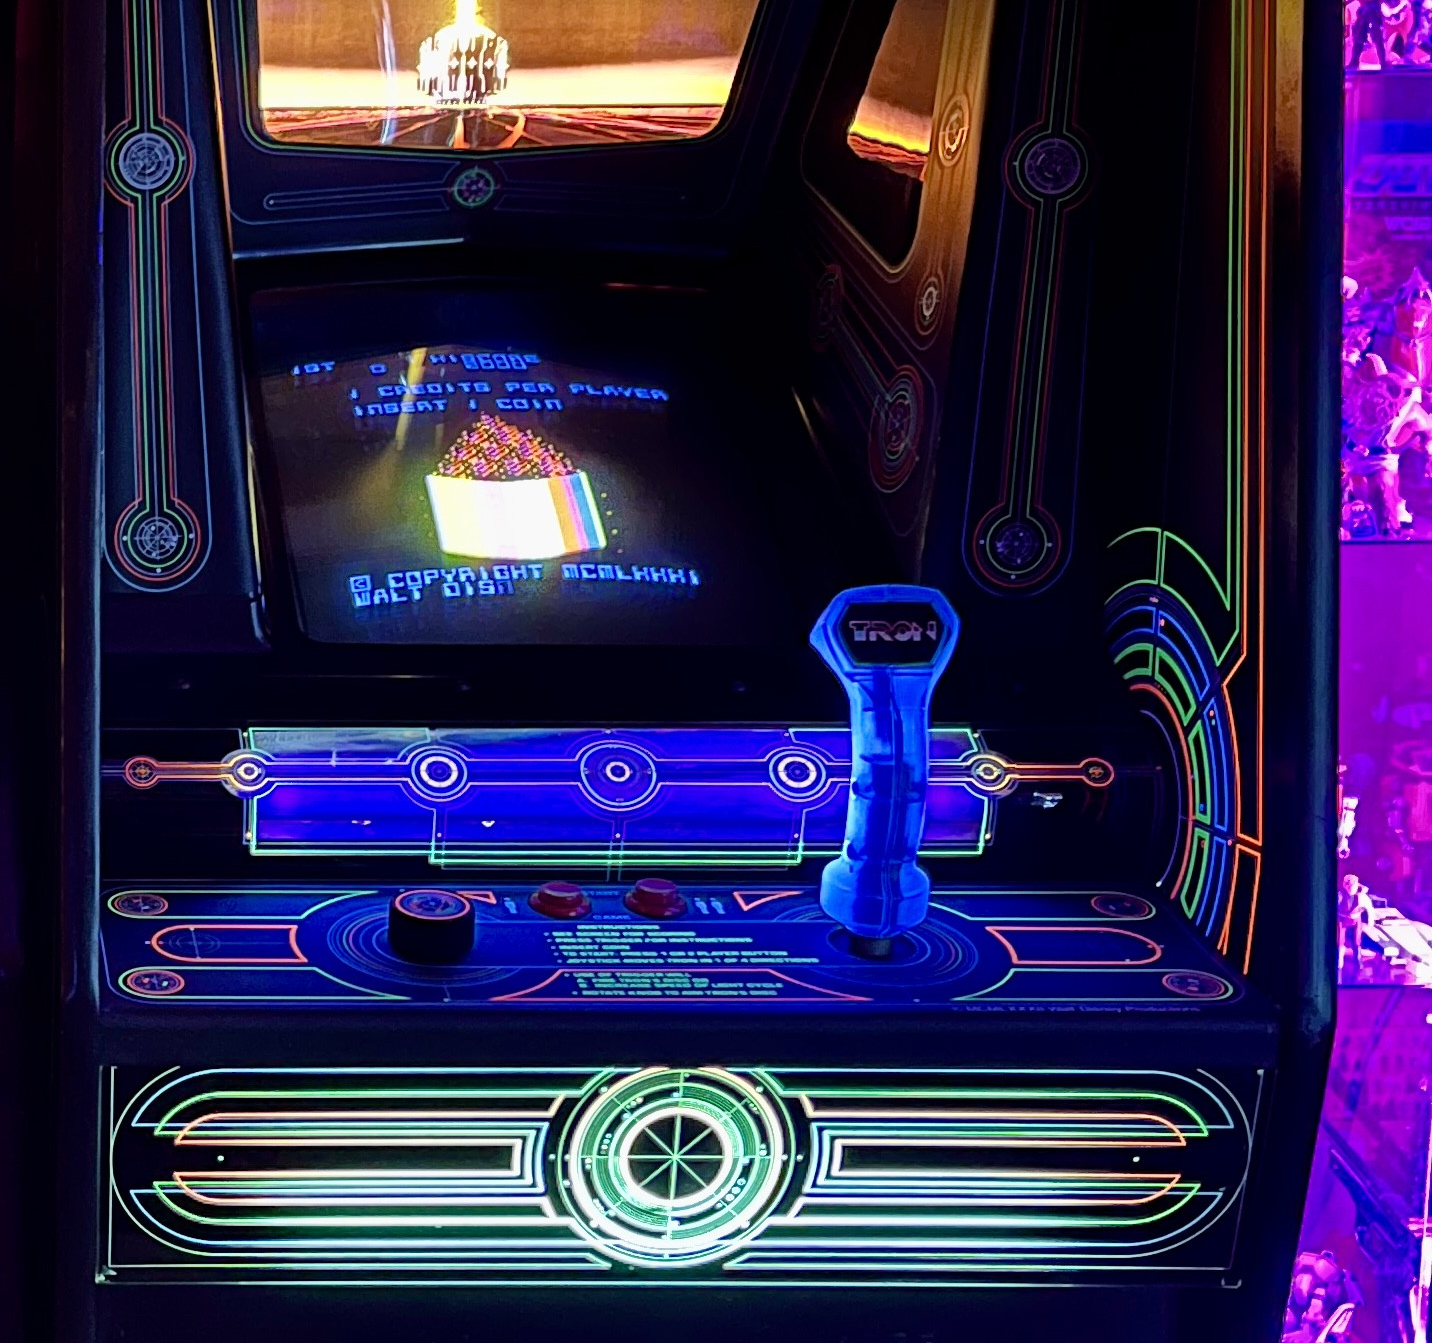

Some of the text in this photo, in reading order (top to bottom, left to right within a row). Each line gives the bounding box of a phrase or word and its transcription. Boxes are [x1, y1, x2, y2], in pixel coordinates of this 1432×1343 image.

[377, 382, 491, 398] CREDITS
[504, 381, 556, 394] PER
[568, 382, 669, 400] PLAYER
[353, 399, 448, 417] INSERT
[496, 397, 564, 411] COIN
[387, 563, 544, 589] COPYRIGHT
[561, 563, 701, 587] MCMLXXXI
[353, 586, 424, 607] WALT
[849, 620, 937, 642] TRON
